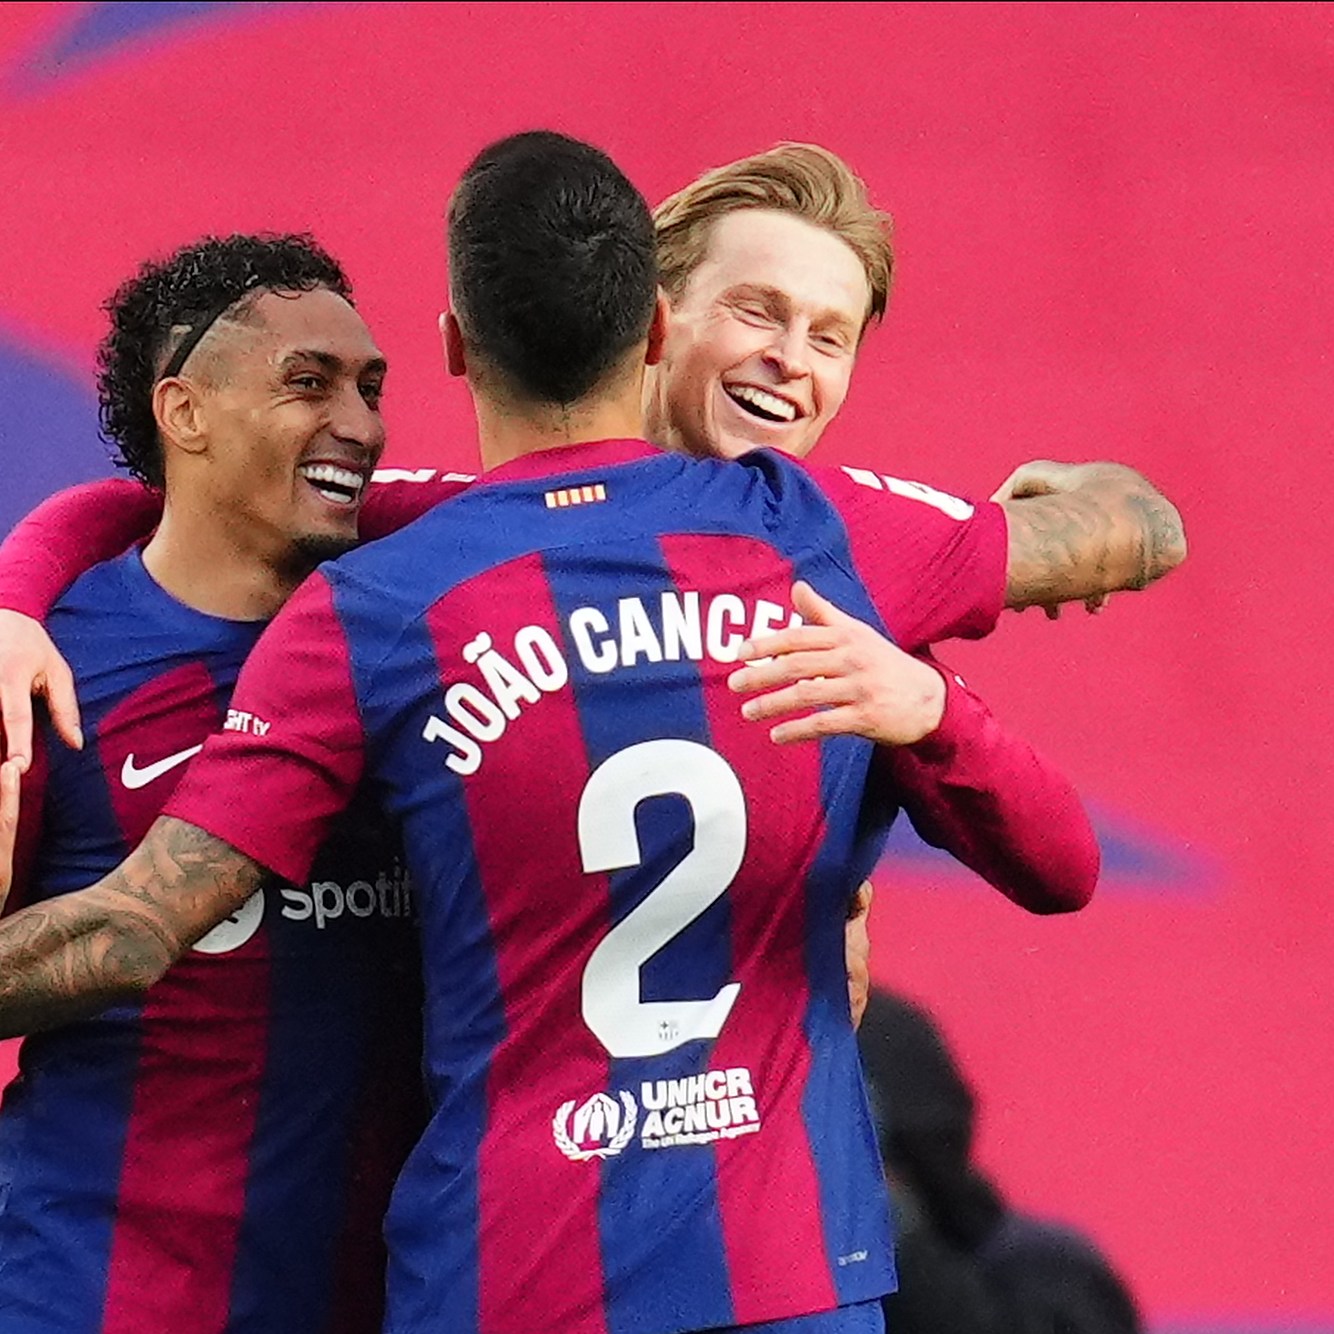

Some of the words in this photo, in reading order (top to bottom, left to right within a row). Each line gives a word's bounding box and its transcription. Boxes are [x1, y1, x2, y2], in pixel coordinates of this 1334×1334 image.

[423, 626, 568, 775] JOÃO
[569, 592, 803, 674] CANCE
[280, 856, 415, 930] Spotif
[578, 739, 747, 1058] 2
[641, 1068, 754, 1110] UNHCR
[641, 1096, 761, 1137] ACNUR
